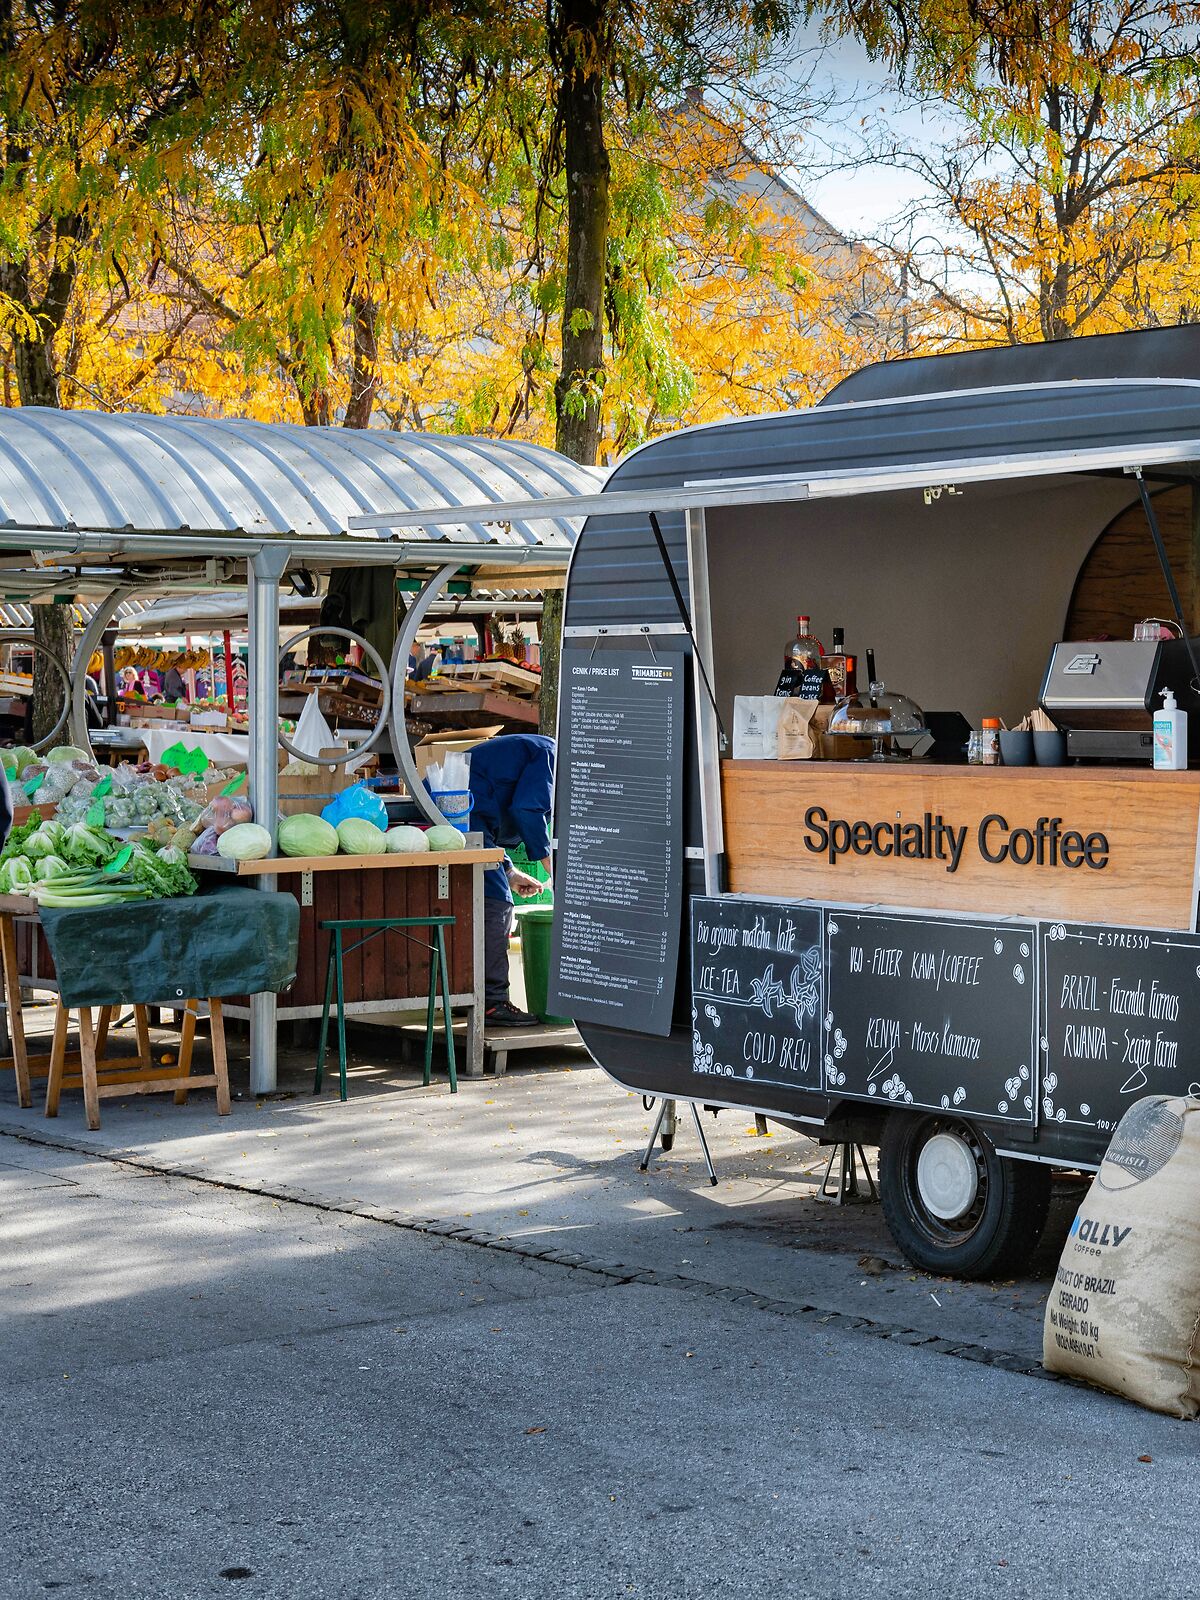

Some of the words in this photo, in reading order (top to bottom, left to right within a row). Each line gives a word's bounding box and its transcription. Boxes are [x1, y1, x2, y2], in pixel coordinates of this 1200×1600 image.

[572, 667, 588, 675] CENIK
[591, 667, 608, 676] PRICE
[608, 668, 620, 676] LIST
[631, 669, 663, 678] TRIMARIJE
[780, 675, 792, 686] gin
[804, 675, 824, 684] Coffee
[775, 686, 792, 697] tonic
[801, 684, 820, 692] beans
[803, 806, 968, 873] Specialty
[978, 813, 1110, 870] Coffee
[697, 920, 709, 943] Bio
[709, 924, 740, 956] organic
[742, 916, 771, 950] matcha
[776, 918, 797, 953] latte
[1098, 933, 1150, 950] ESPRESSO
[872, 947, 903, 977] FILTER
[1060, 974, 1101, 1012] BRAZIL
[1109, 977, 1146, 1017] Fazenda
[743, 1031, 775, 1065] COLD
[779, 1037, 811, 1073] BREW
[1063, 1024, 1108, 1061] RWANDA
[1153, 1030, 1178, 1068] Farm
[1073, 1273, 1085, 1289] OF
[1084, 1275, 1117, 1295] BRAZIL
[1059, 1289, 1089, 1314] CERRADO
[1080, 1320, 1089, 1337] 60
[1089, 1321, 1100, 1342] kg
